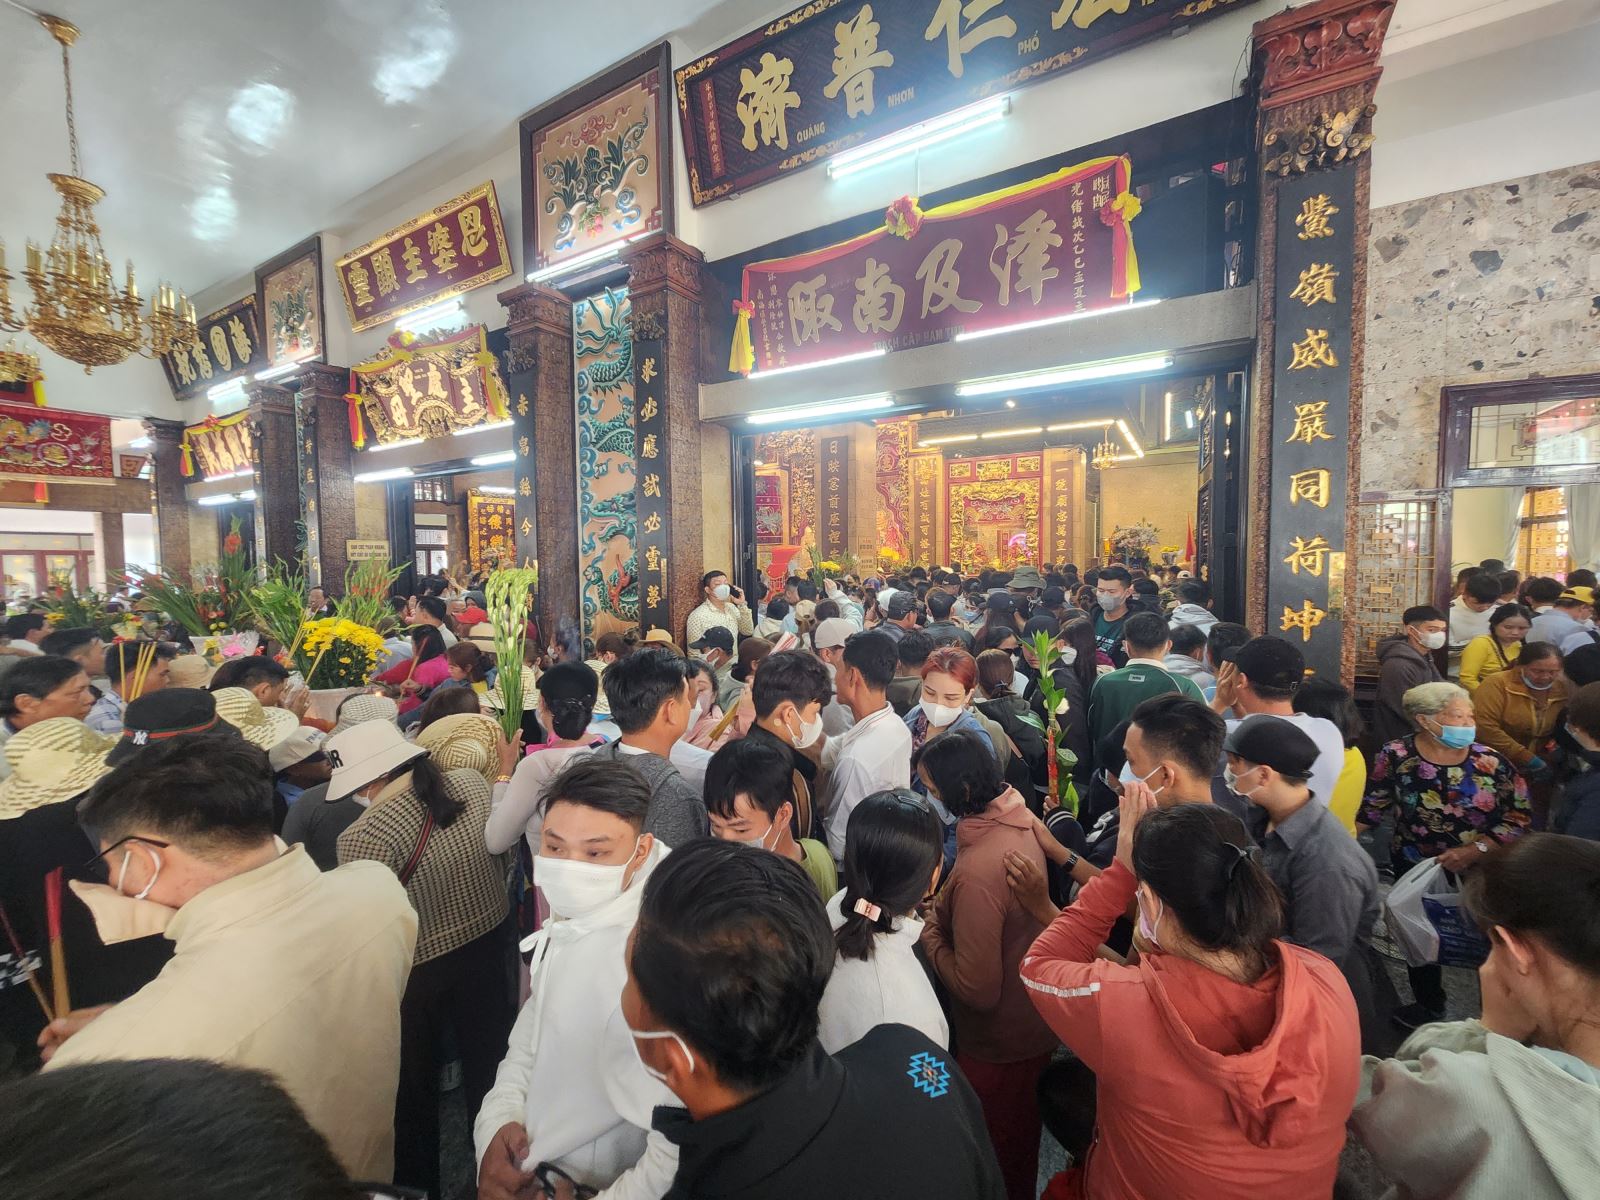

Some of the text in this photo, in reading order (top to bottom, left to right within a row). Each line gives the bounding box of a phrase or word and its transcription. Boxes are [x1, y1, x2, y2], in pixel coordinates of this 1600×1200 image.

[640, 357, 663, 629] 求必應試必靈夢
